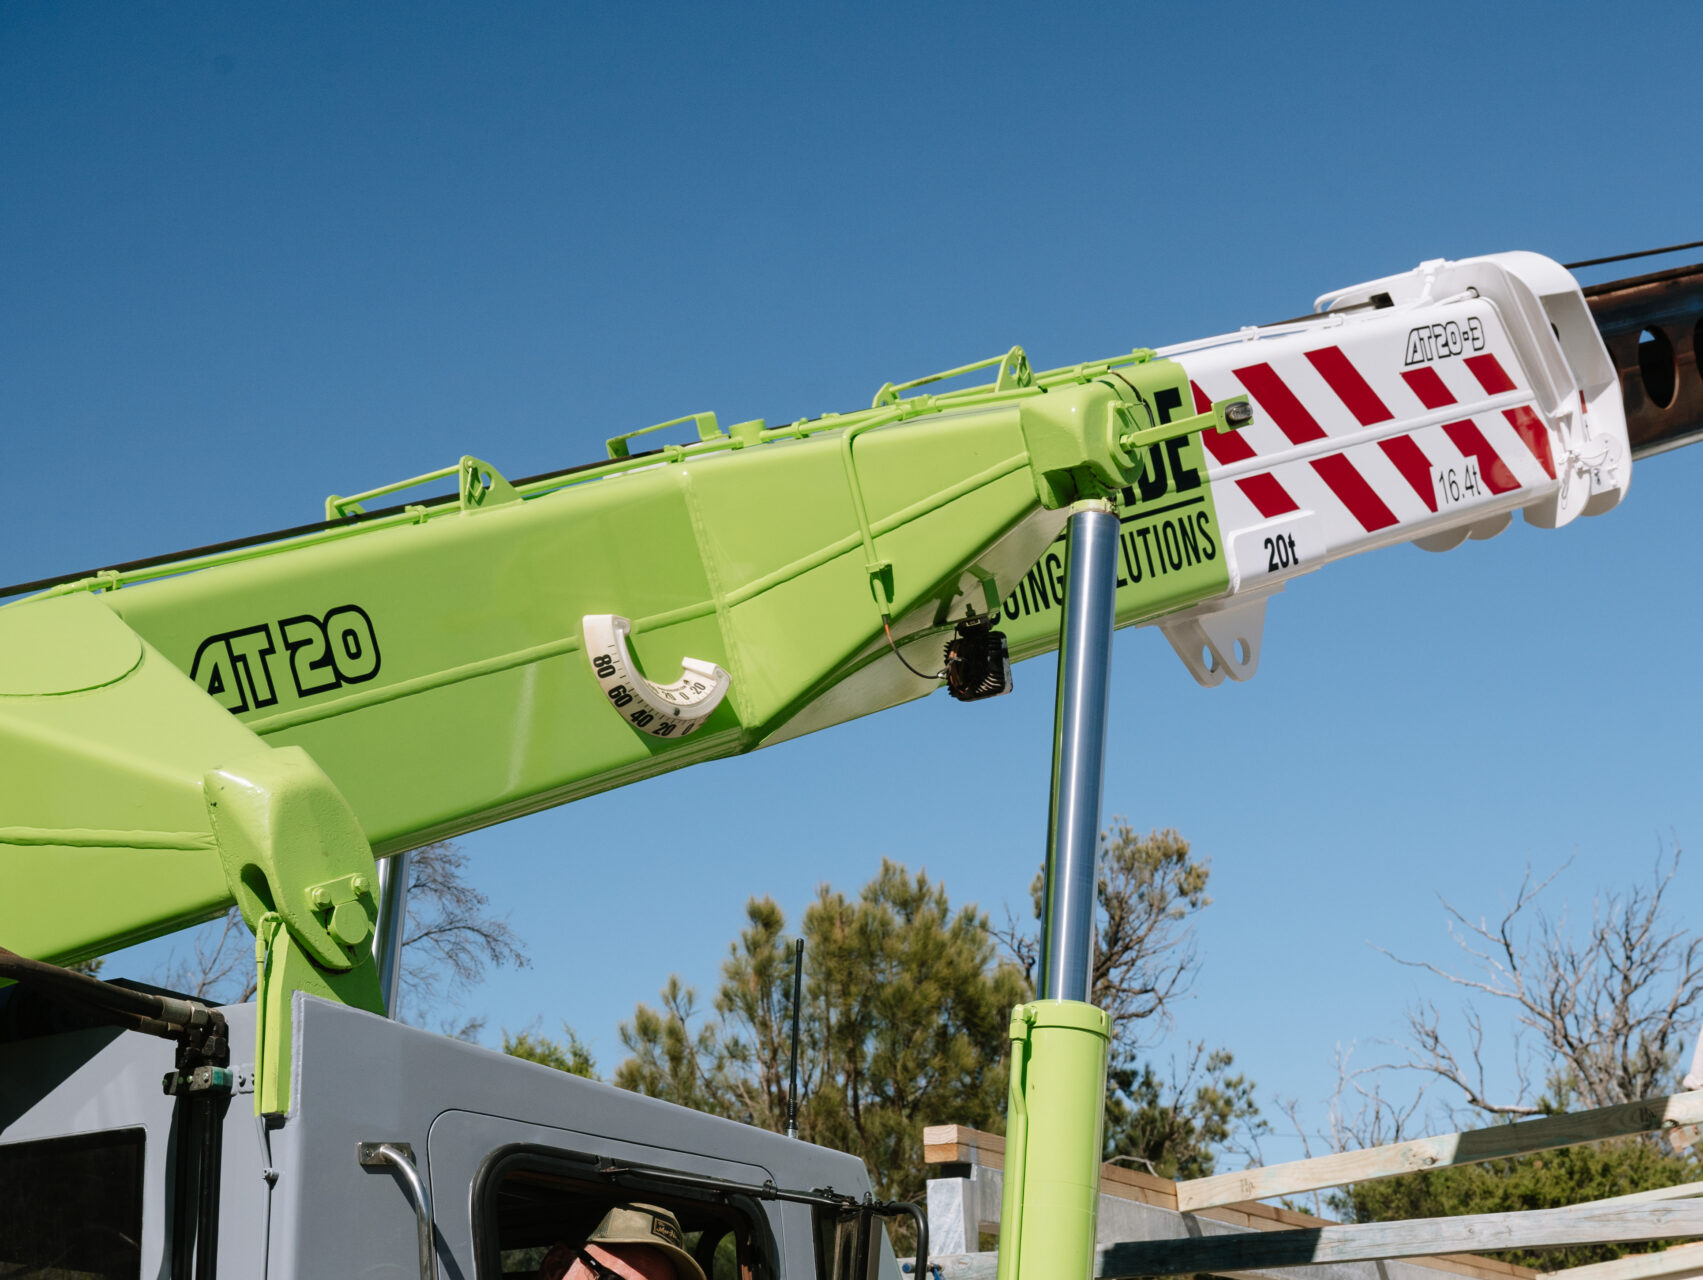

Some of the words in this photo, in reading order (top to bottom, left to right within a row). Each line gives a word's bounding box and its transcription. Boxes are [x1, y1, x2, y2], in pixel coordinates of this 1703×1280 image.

[1405, 316, 1485, 366] AT20-3
[1439, 464, 1481, 504] 16.4t
[1116, 511, 1216, 588] UTIONS
[1264, 533, 1299, 573] 20t
[593, 654, 616, 679] 80
[608, 684, 633, 708] 60
[630, 709, 654, 728] 40
[652, 722, 677, 736] 20
[681, 722, 695, 736] 0
